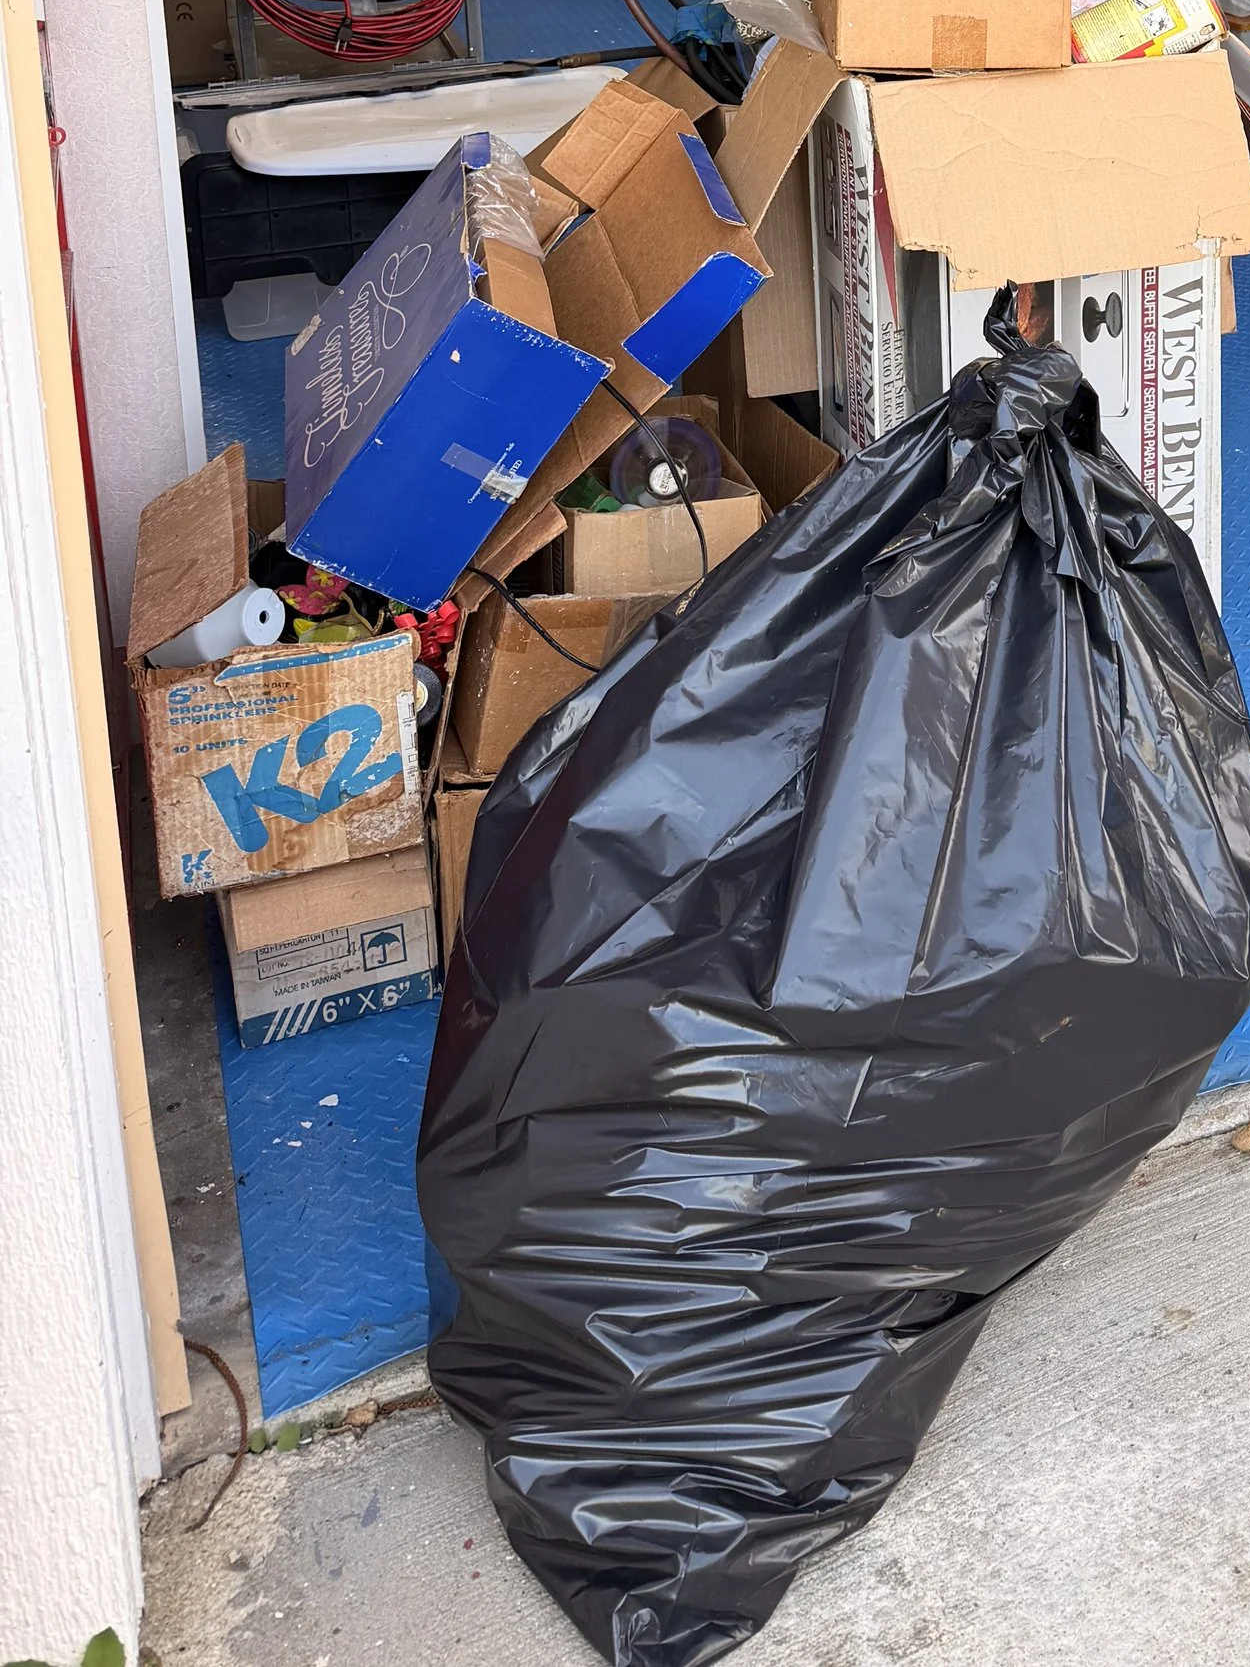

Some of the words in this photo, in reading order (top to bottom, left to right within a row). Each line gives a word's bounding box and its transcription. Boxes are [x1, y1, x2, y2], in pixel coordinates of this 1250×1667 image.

[839, 132, 849, 198] SERVIDOR
[846, 137, 857, 230] STAINLESS
[855, 164, 872, 304] WEST
[1144, 270, 1156, 290] EEL
[1144, 290, 1156, 329] BUFFET
[881, 321, 893, 378] SERVICIO
[893, 328, 907, 385] ELEGANT
[1144, 331, 1156, 372] SERVER
[1161, 275, 1203, 408] WEST
[304, 325, 349, 468] Timeless
[859, 308, 876, 443] BEND
[883, 380, 895, 428] ELEGAN
[895, 385, 908, 422] SERVI
[1143, 387, 1156, 438] SERVIDOR
[1143, 439, 1156, 468] PARA
[1162, 417, 1202, 536] BEND
[168, 694, 299, 715] PROFESSIONAL
[169, 706, 278, 726] SPRINKLERS
[173, 744, 190, 755] 10
[195, 736, 249, 752] UNITS
[201, 703, 403, 854] K2
[273, 984, 299, 998] MADE
[300, 981, 309, 991] IN
[311, 973, 342, 988] TAIWAN
[322, 995, 351, 1024] 6"
[357, 989, 378, 1015] X
